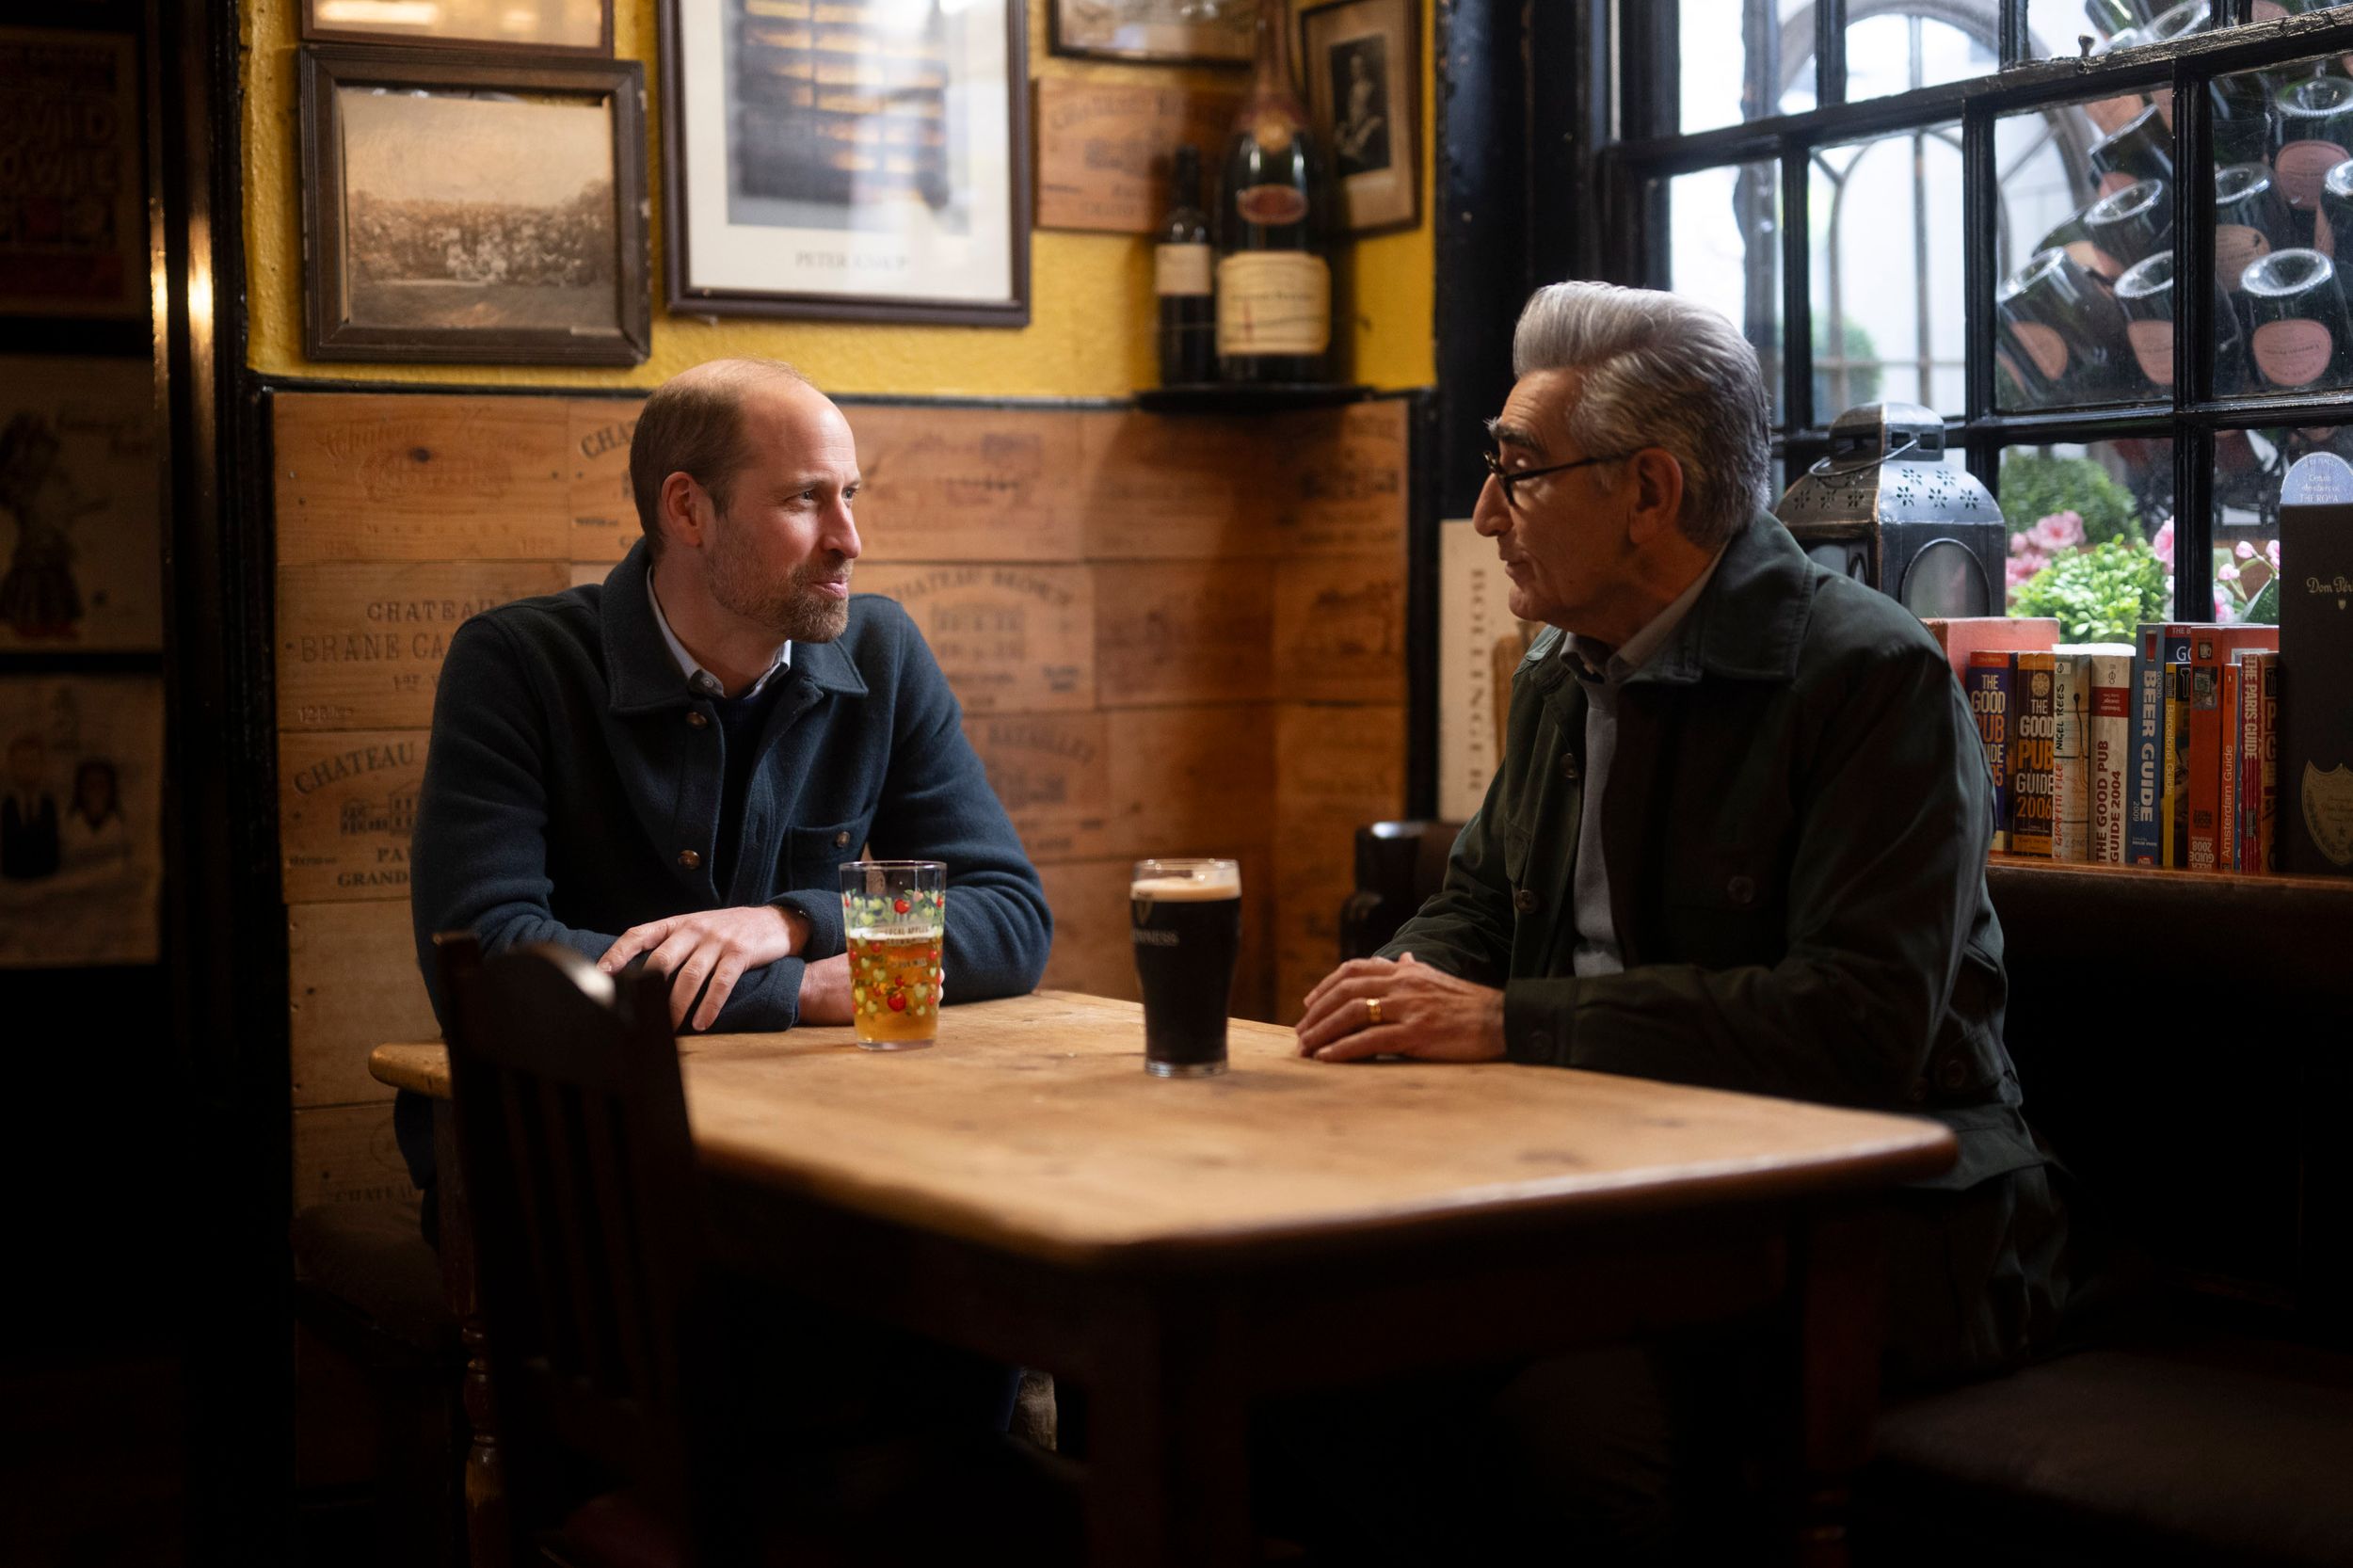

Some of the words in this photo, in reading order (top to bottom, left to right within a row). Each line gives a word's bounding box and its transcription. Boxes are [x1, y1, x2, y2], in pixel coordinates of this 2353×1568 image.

[2306, 577, 2332, 594] Dom
[299, 632, 400, 664] BRANE
[1981, 675, 1999, 690] THE
[2245, 655, 2259, 683] THE
[1971, 690, 2006, 714] GOOD
[2030, 699, 2048, 714] THE
[2055, 683, 2064, 716] REES
[2141, 670, 2156, 737] BEER
[2244, 683, 2258, 721] PARIS
[2019, 715, 2054, 738] GOOD
[2056, 721, 2064, 751] NIGEL
[2166, 704, 2174, 761] Barcelona
[2244, 722, 2258, 760] GUIDE
[293, 741, 415, 796] CHATEAU
[2017, 739, 2054, 770] PUB
[2097, 740, 2109, 773] PUB
[2222, 744, 2233, 782] Guide
[2015, 772, 2054, 795] GUIDE
[2110, 770, 2121, 809] 2004
[2139, 743, 2154, 822] GUIDE
[2166, 762, 2174, 796] Guide
[2016, 795, 2052, 820] 2006
[2096, 777, 2108, 827] GOOD
[2222, 785, 2233, 857] Amsterdam
[2096, 831, 2107, 863] THE
[2109, 812, 2121, 863] GUIDE
[2191, 840, 2213, 853] 2008
[2188, 851, 2215, 863] GUIDE
